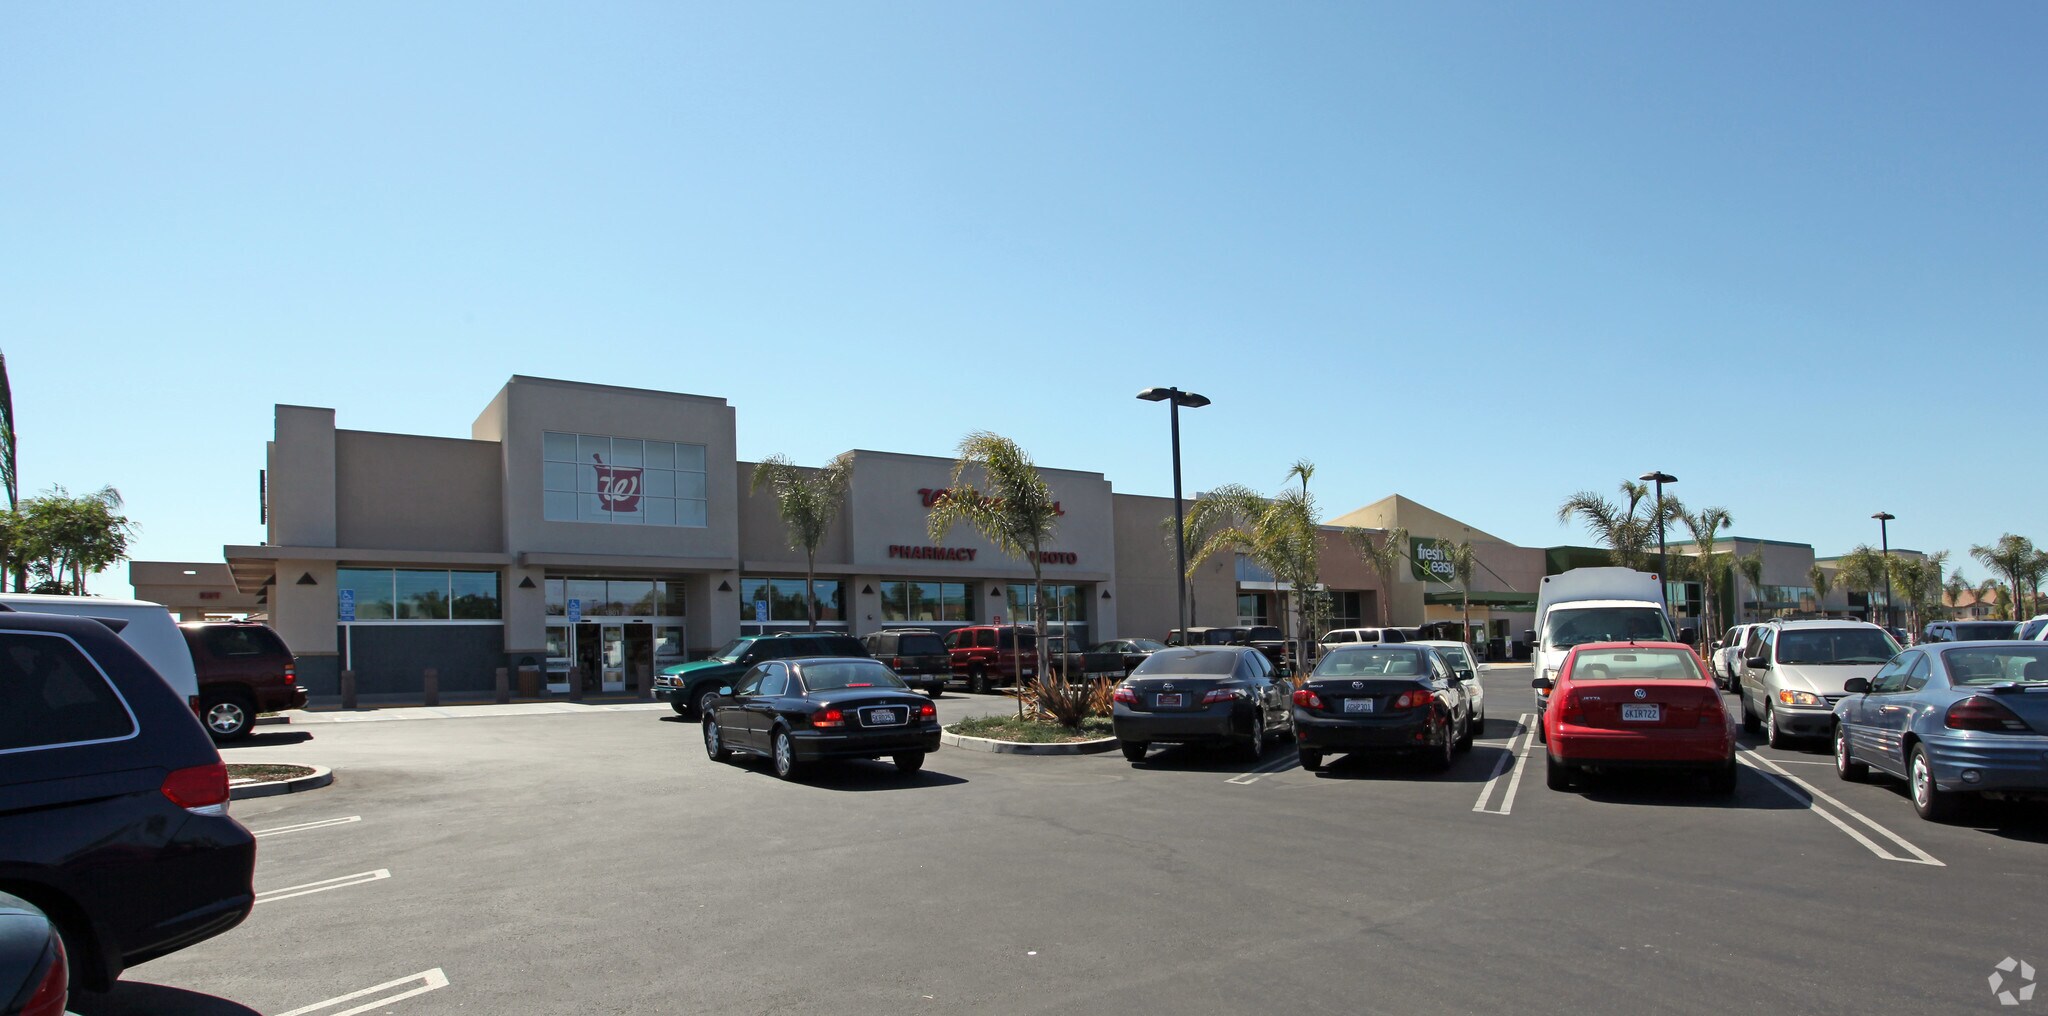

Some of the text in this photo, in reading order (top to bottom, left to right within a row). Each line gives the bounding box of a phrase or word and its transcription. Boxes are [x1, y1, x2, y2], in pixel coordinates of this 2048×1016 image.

[889, 545, 977, 561] PHARMACY
[1416, 543, 1444, 561] fresh
[1431, 561, 1455, 579] easy
[1624, 709, 1657, 719] 6KIR722
